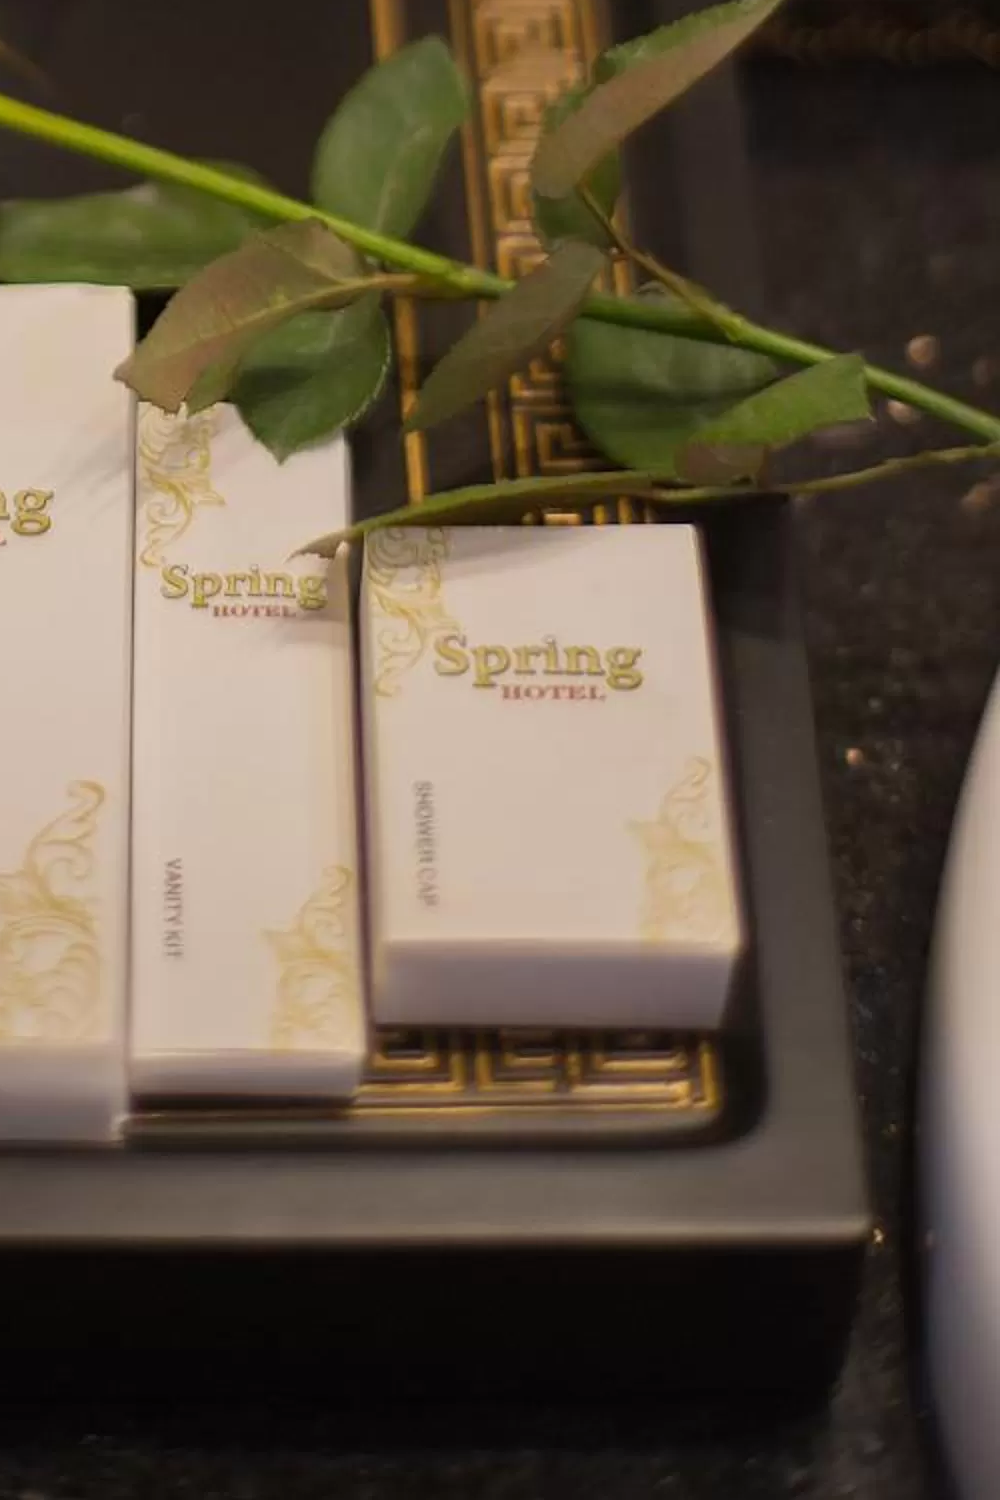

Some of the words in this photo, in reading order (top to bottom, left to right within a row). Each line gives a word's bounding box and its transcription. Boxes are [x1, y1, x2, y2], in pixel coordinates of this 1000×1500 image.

[161, 563, 328, 611] Spring
[212, 604, 297, 618] HOTEL
[434, 634, 644, 689] Spring
[502, 684, 607, 701] HOTEL
[163, 857, 183, 924] VANITY
